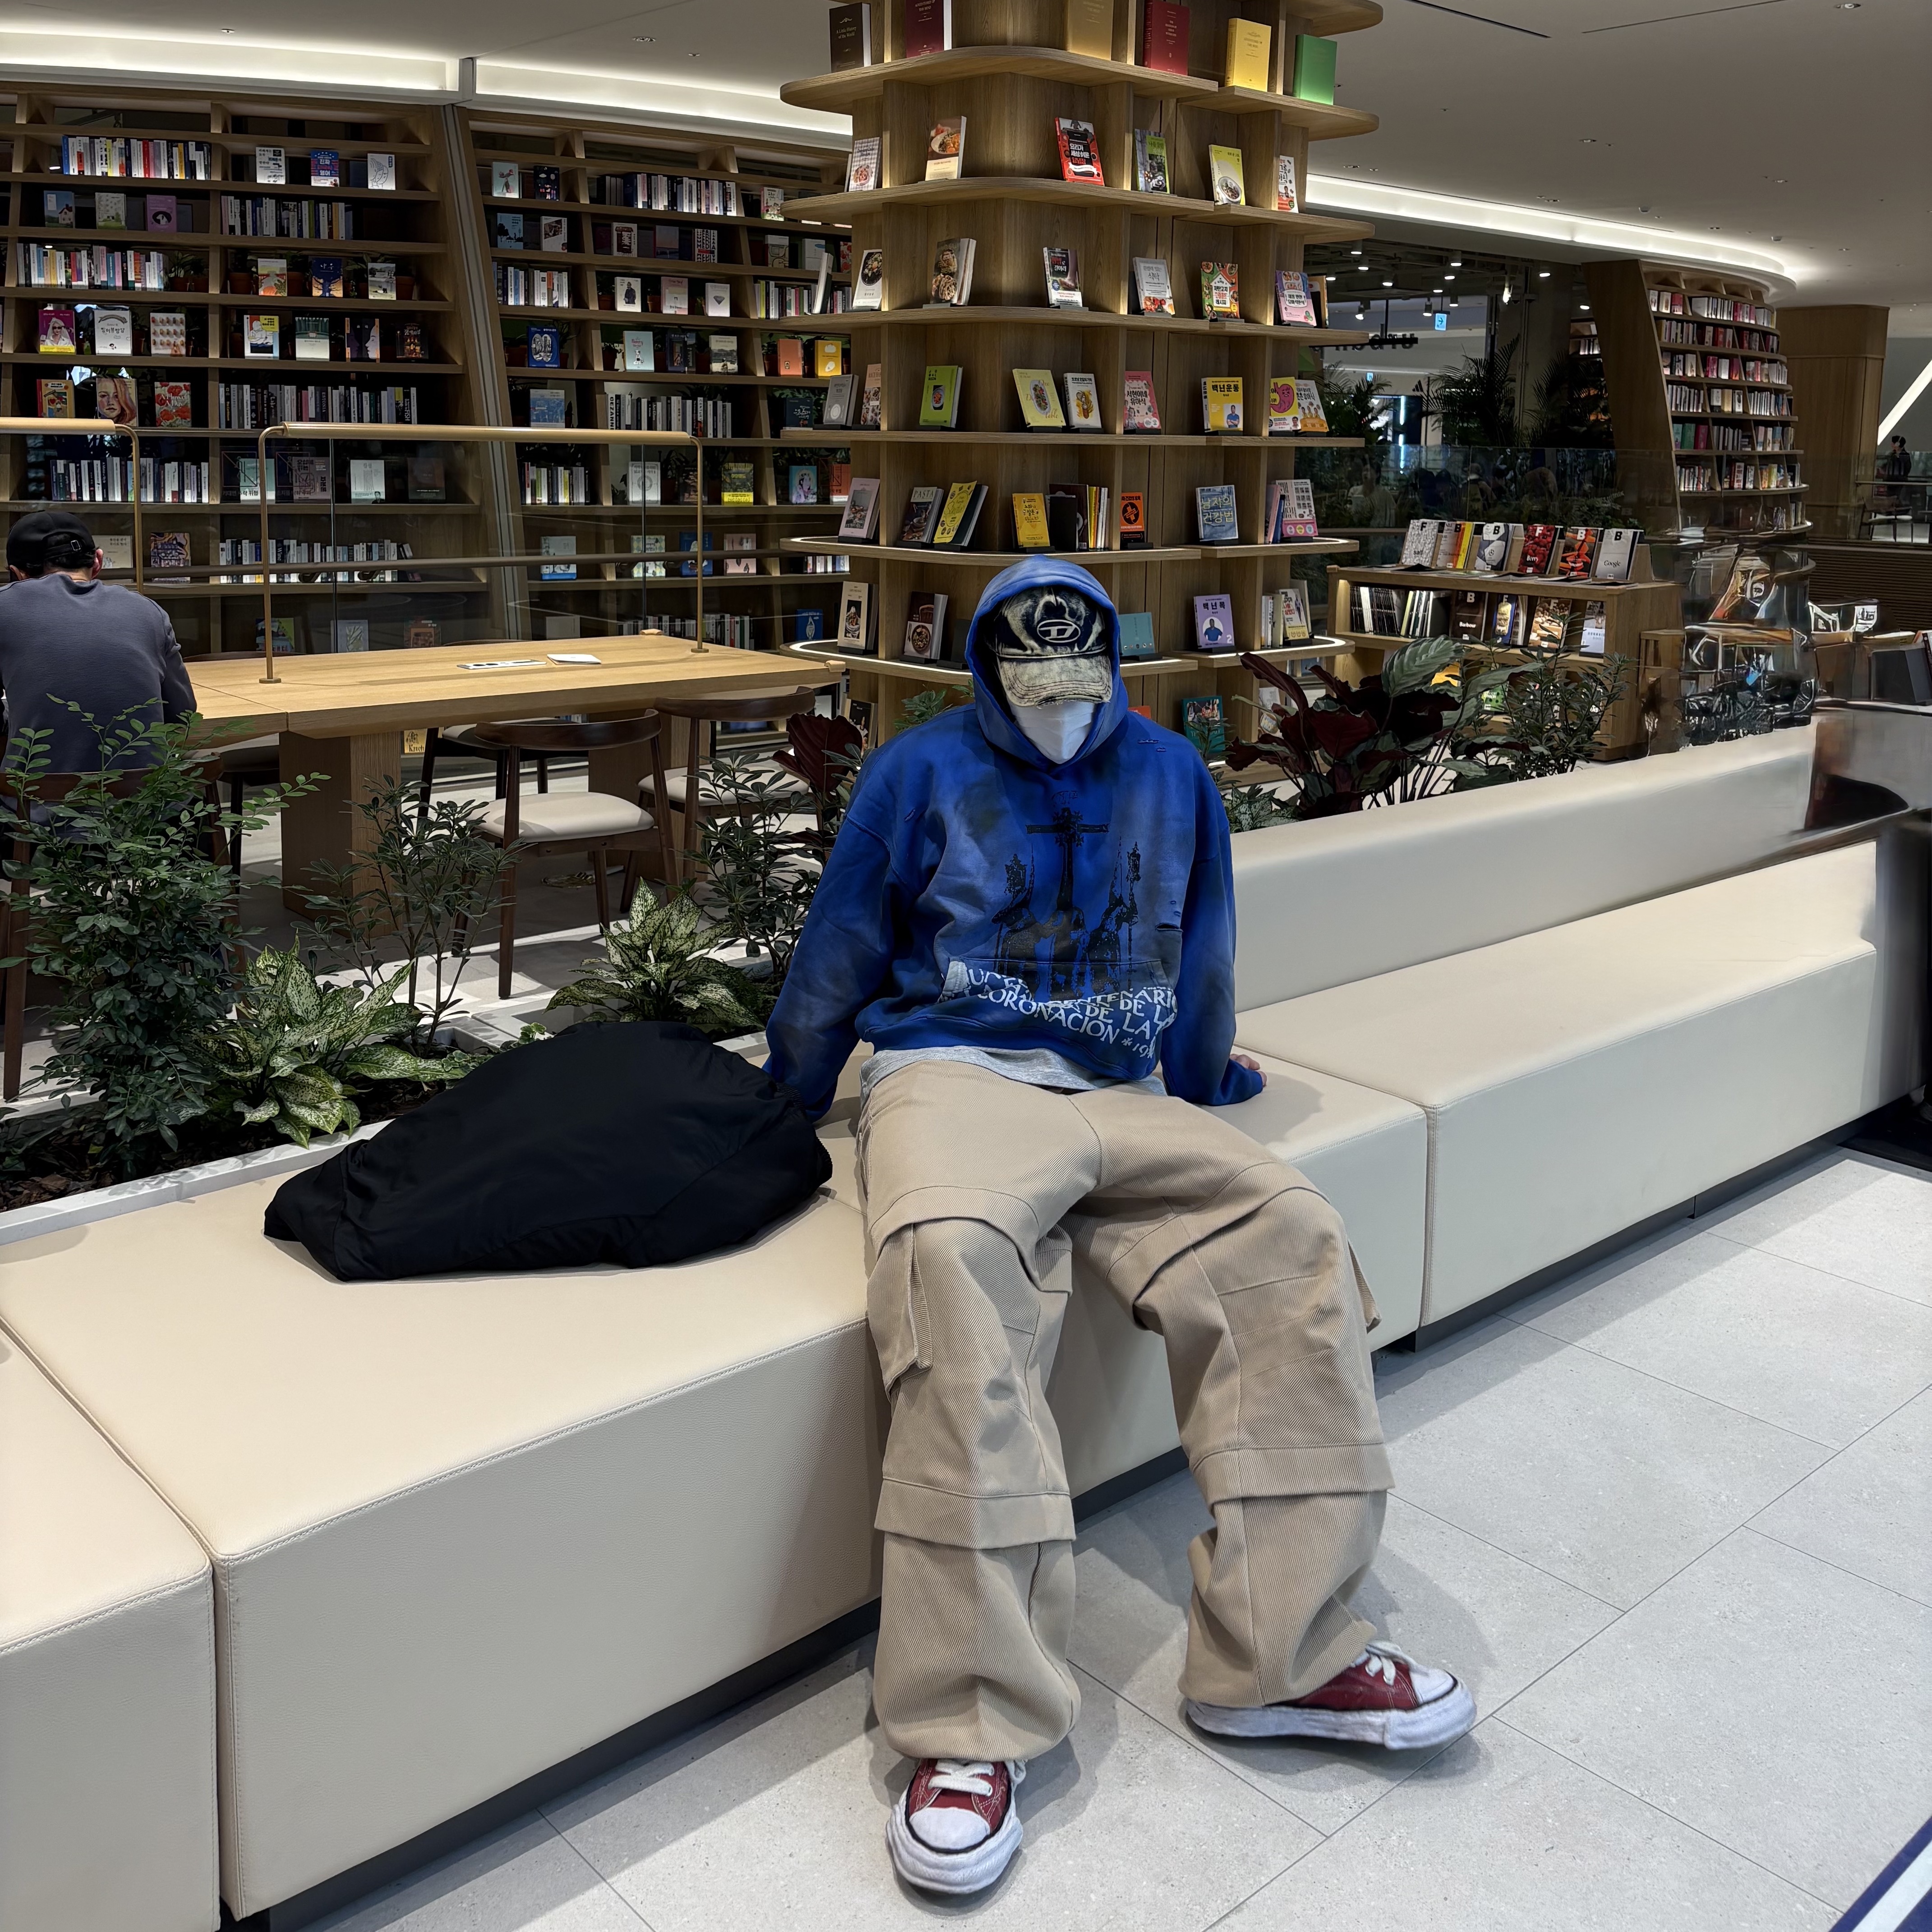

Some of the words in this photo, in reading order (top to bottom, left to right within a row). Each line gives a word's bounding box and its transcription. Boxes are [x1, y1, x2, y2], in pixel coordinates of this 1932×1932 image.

[1212, 384, 1239, 392] 백년운동
[913, 490, 934, 498] PASTA
[1202, 496, 1233, 509] 남자의
[1203, 511, 1233, 524] 건강법
[1454, 524, 1462, 532] B
[1493, 525, 1500, 534] B
[1535, 526, 1543, 536] F
[1614, 531, 1623, 541] B
[1466, 592, 1475, 603] B
[1227, 634, 1232, 644] 2
[1120, 999, 1146, 1017] DE
[1085, 1004, 1114, 1024] DE
[1122, 1012, 1150, 1040] LA
